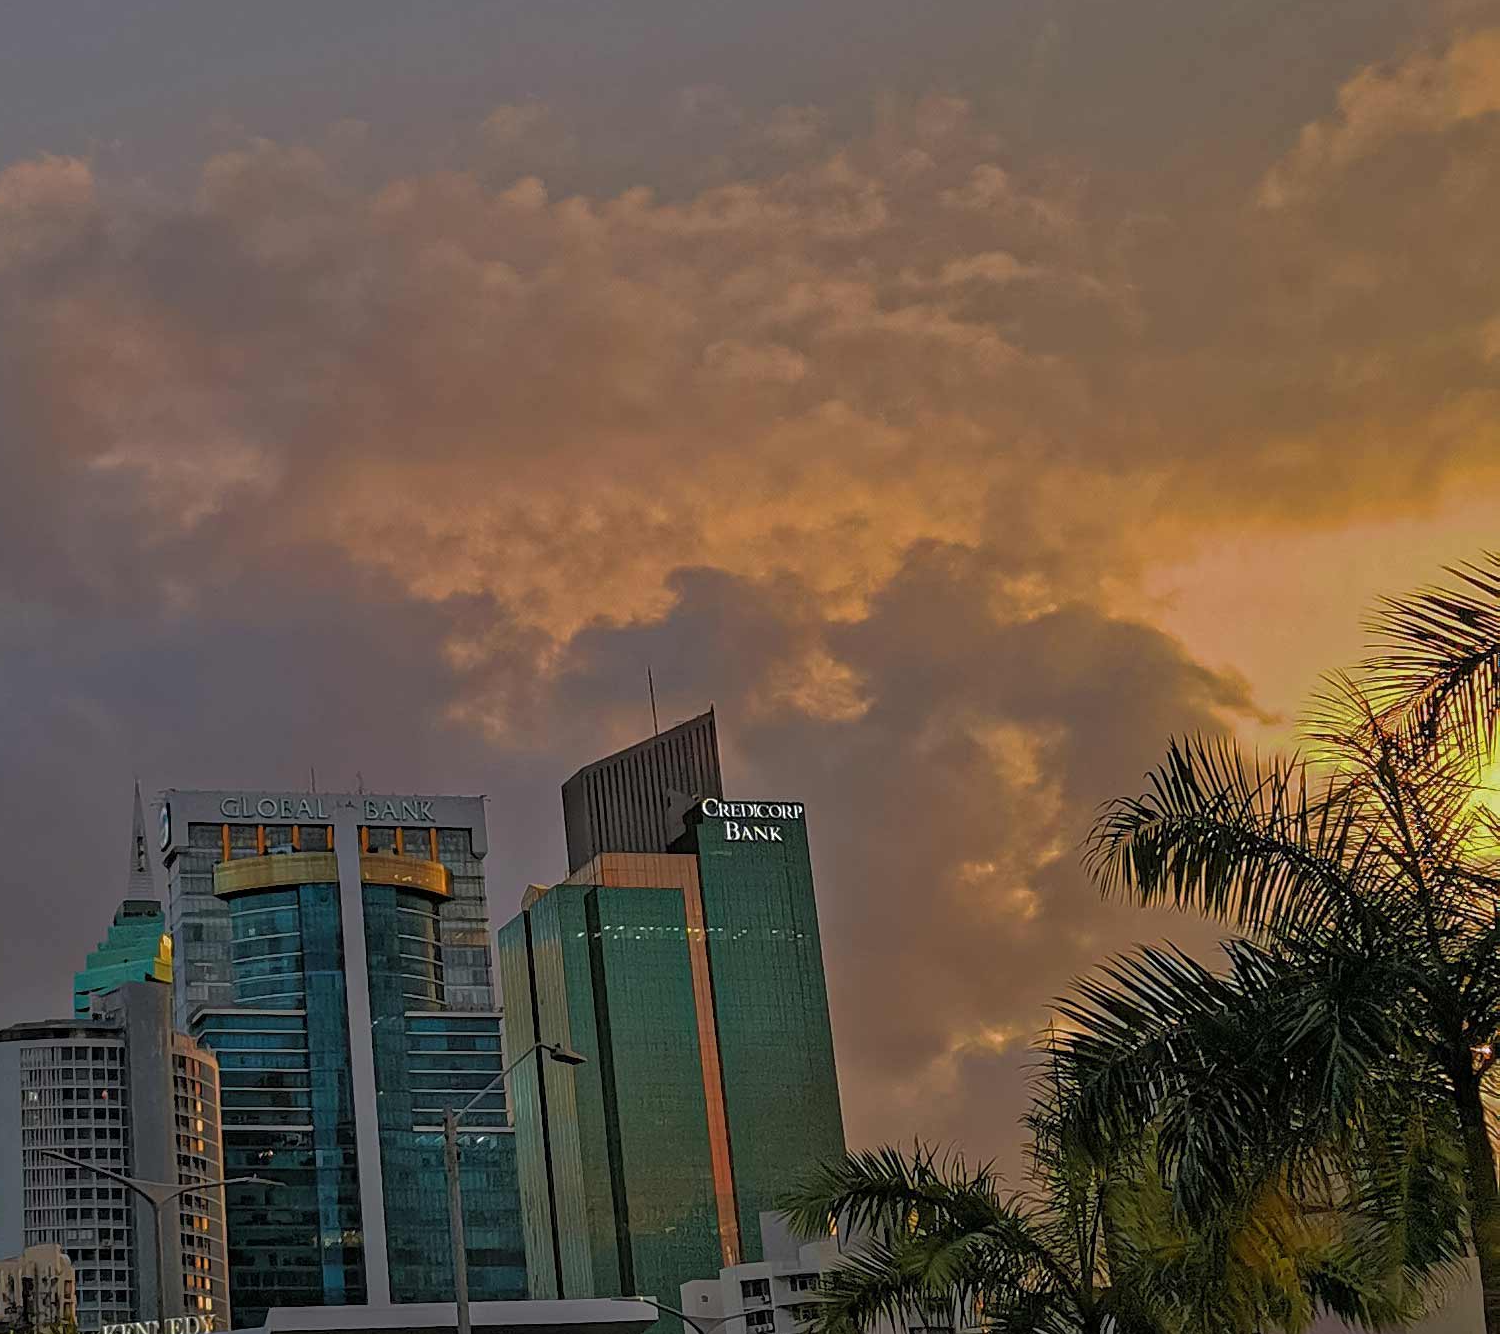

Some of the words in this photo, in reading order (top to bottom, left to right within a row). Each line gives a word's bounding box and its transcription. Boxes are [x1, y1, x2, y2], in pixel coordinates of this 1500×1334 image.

[220, 796, 331, 819] GLOBAL
[363, 799, 436, 822] BANK
[702, 798, 803, 819] CREDICORP
[725, 820, 783, 842] BANK
